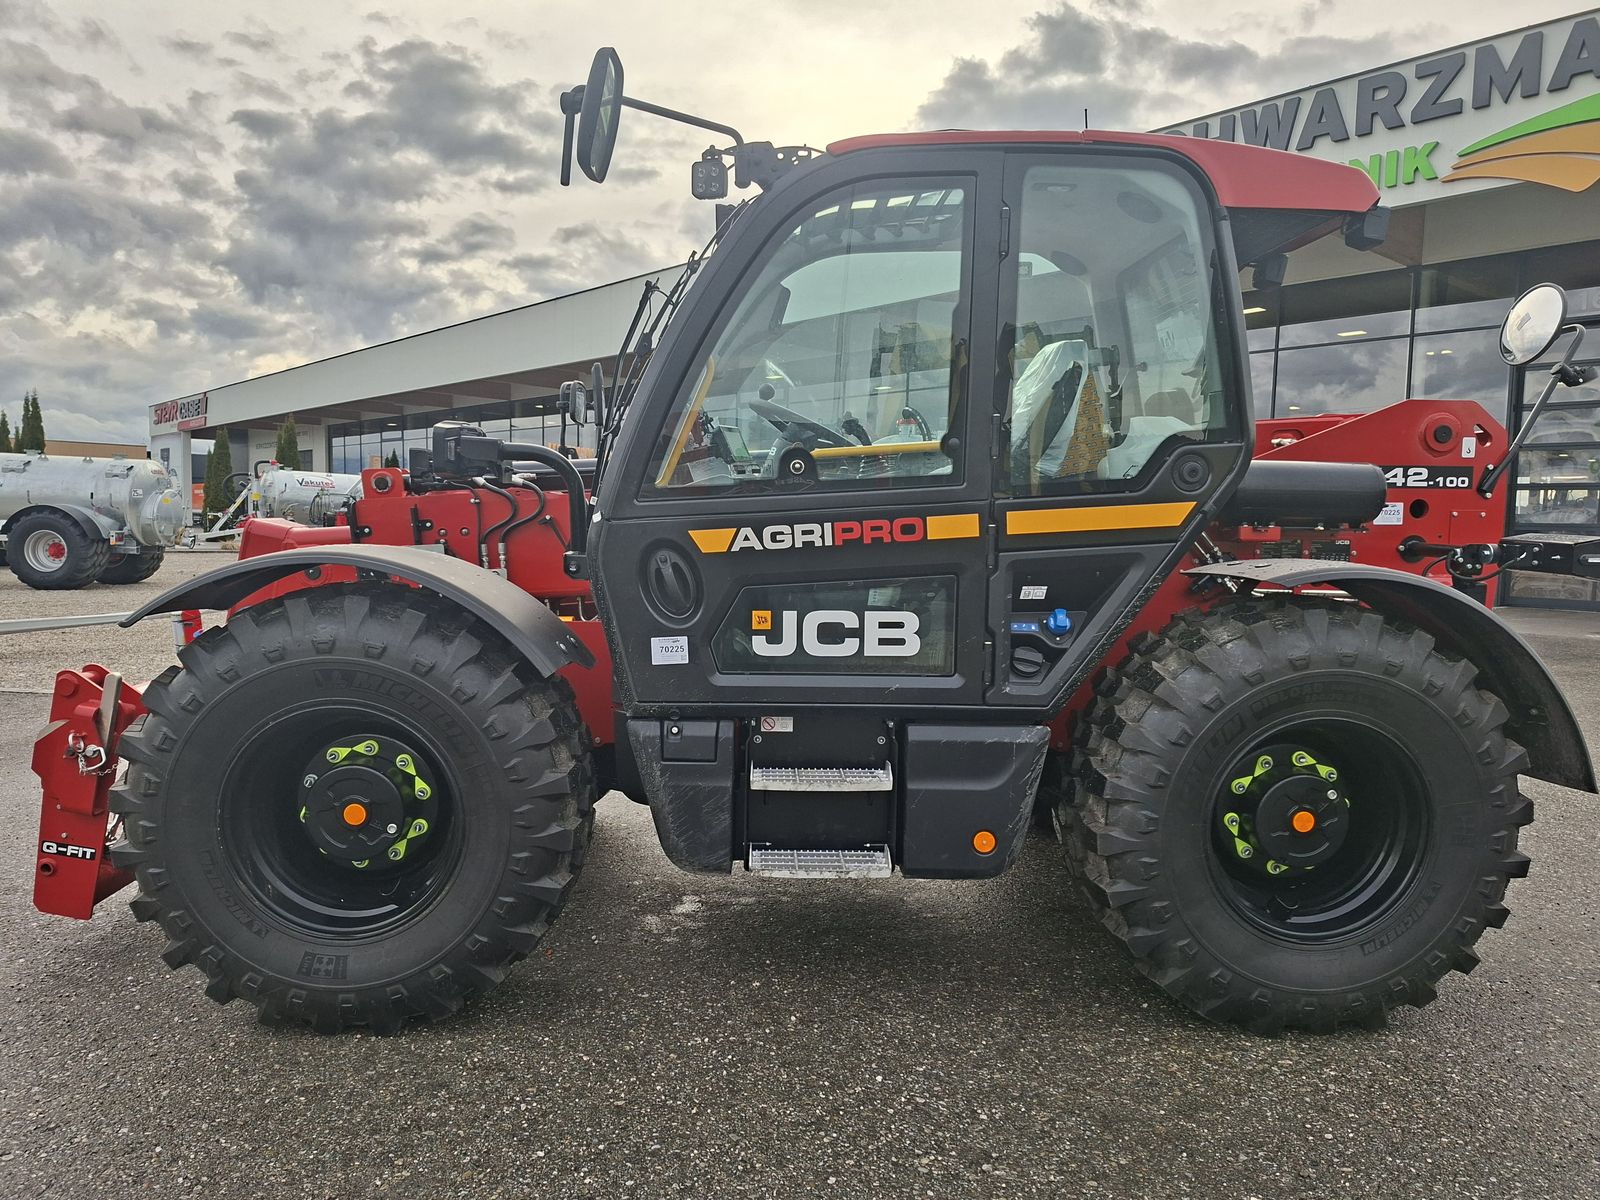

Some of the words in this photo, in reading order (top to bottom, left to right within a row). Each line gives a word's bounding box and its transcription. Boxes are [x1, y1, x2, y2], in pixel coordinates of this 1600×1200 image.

[1165, 16, 1600, 151] WARZMA
[296, 478, 335, 487] Vakutec
[730, 516, 924, 552] AGRIPRO
[751, 610, 921, 657] JCB
[659, 645, 685, 653] 70225
[42, 841, 96, 859] Q-FIT
